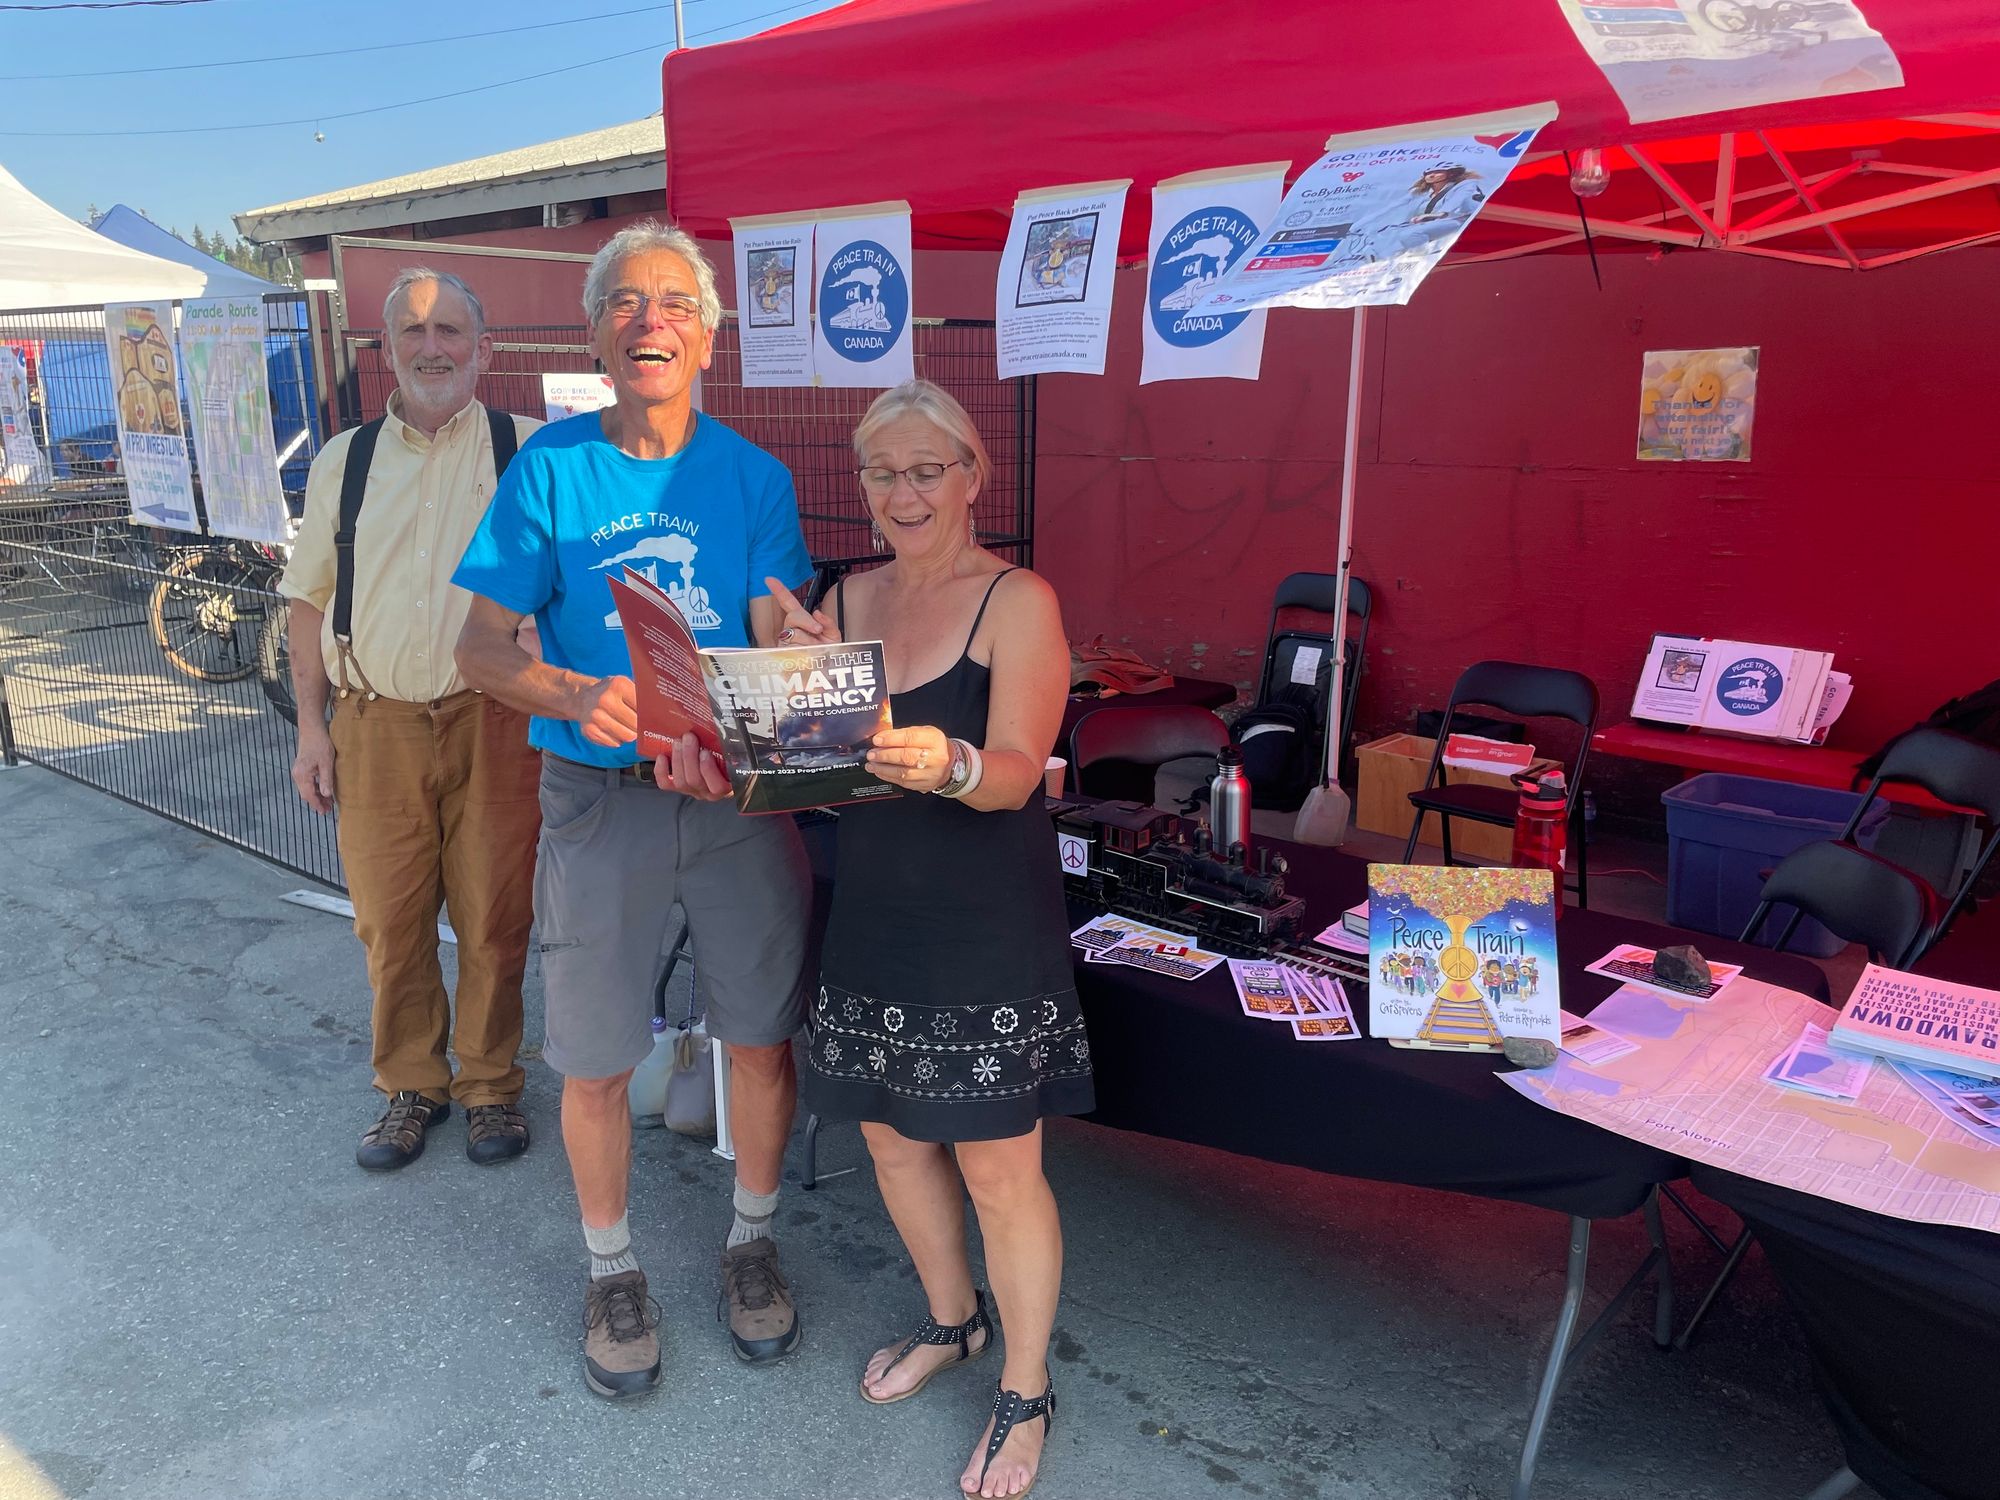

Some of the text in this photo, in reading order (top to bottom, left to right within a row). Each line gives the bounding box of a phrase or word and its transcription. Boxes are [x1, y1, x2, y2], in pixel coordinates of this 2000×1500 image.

[1368, 157, 1393, 167] OCT
[1409, 153, 1441, 162] 2024
[1169, 217, 1209, 249] PEACE
[1210, 216, 1255, 246] TRAIN
[1277, 232, 1287, 241] 1
[1263, 245, 1276, 256] 2
[832, 249, 896, 277] PEACE TRAIN
[1250, 260, 1263, 269] 3
[186, 303, 259, 319] Parade Route
[1172, 316, 1224, 334] CANADA
[843, 336, 884, 349] CANADA
[145, 435, 185, 457] WRESTLING
[590, 511, 700, 547] PEACE TRAIN
[709, 650, 874, 675] CONFRONT THE
[1731, 661, 1779, 678] PEACE TRAIN
[714, 664, 876, 696] CLIMATE
[717, 686, 877, 710] EMERGENCY
[797, 710, 813, 718] THE
[813, 708, 825, 716] BC
[825, 704, 879, 716] GOVERNMENT
[1731, 702, 1760, 711] CANADA
[643, 729, 675, 744] CONFRO
[735, 768, 776, 776] November
[797, 766, 832, 775] Progress
[833, 761, 861, 770] Report
[1388, 915, 1525, 956] Peace Train
[1863, 984, 1921, 1003] WARMING
[1867, 977, 1918, 994] HAWKEN
[1860, 991, 1875, 1000] TO
[1924, 989, 1953, 1001] PAUL
[1961, 997, 1976, 1005] BY
[1379, 1002, 1423, 1017] Cat Stevens
[1880, 995, 1948, 1015] PROPOSED
[1926, 997, 1969, 1011] GLOBAL
[1499, 1011, 1515, 1024] Peter
[1521, 1013, 1552, 1029] Reynolds
[1857, 998, 1996, 1032] MOST COMPREHENSIVE
[1953, 1010, 1985, 1022] EVER
[1644, 1118, 1734, 1150] Port Alberni
